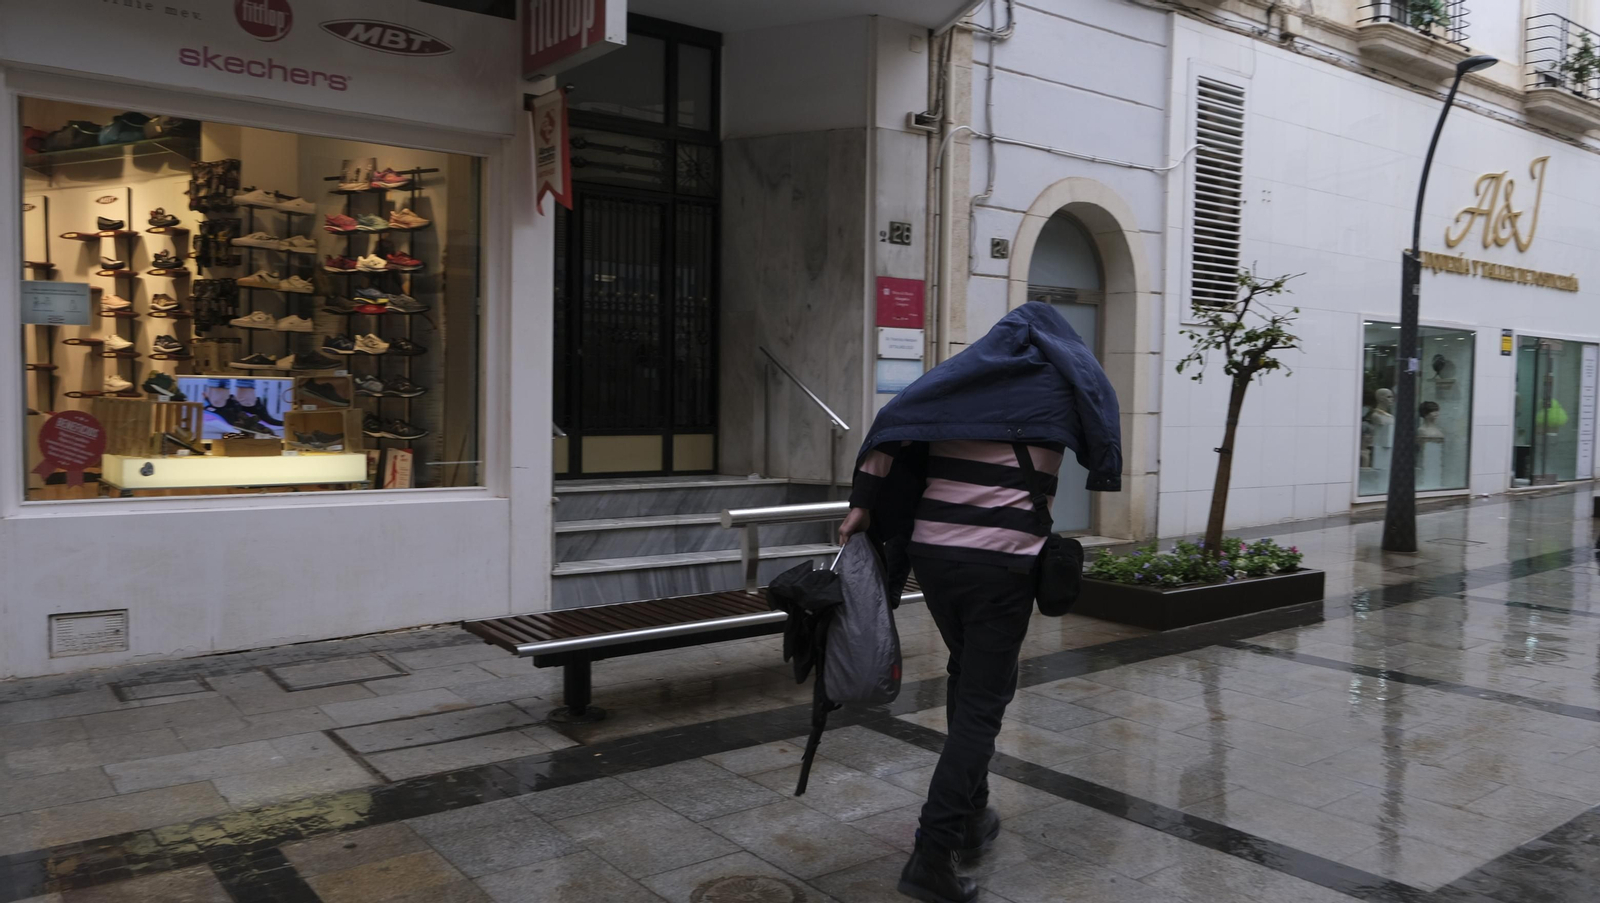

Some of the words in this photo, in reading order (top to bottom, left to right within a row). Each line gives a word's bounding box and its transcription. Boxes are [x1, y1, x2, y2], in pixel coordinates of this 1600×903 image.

[346, 23, 434, 51] MBT
[178, 46, 348, 91] skechers
[1444, 155, 1551, 253] A&J
[891, 222, 911, 244] 28
